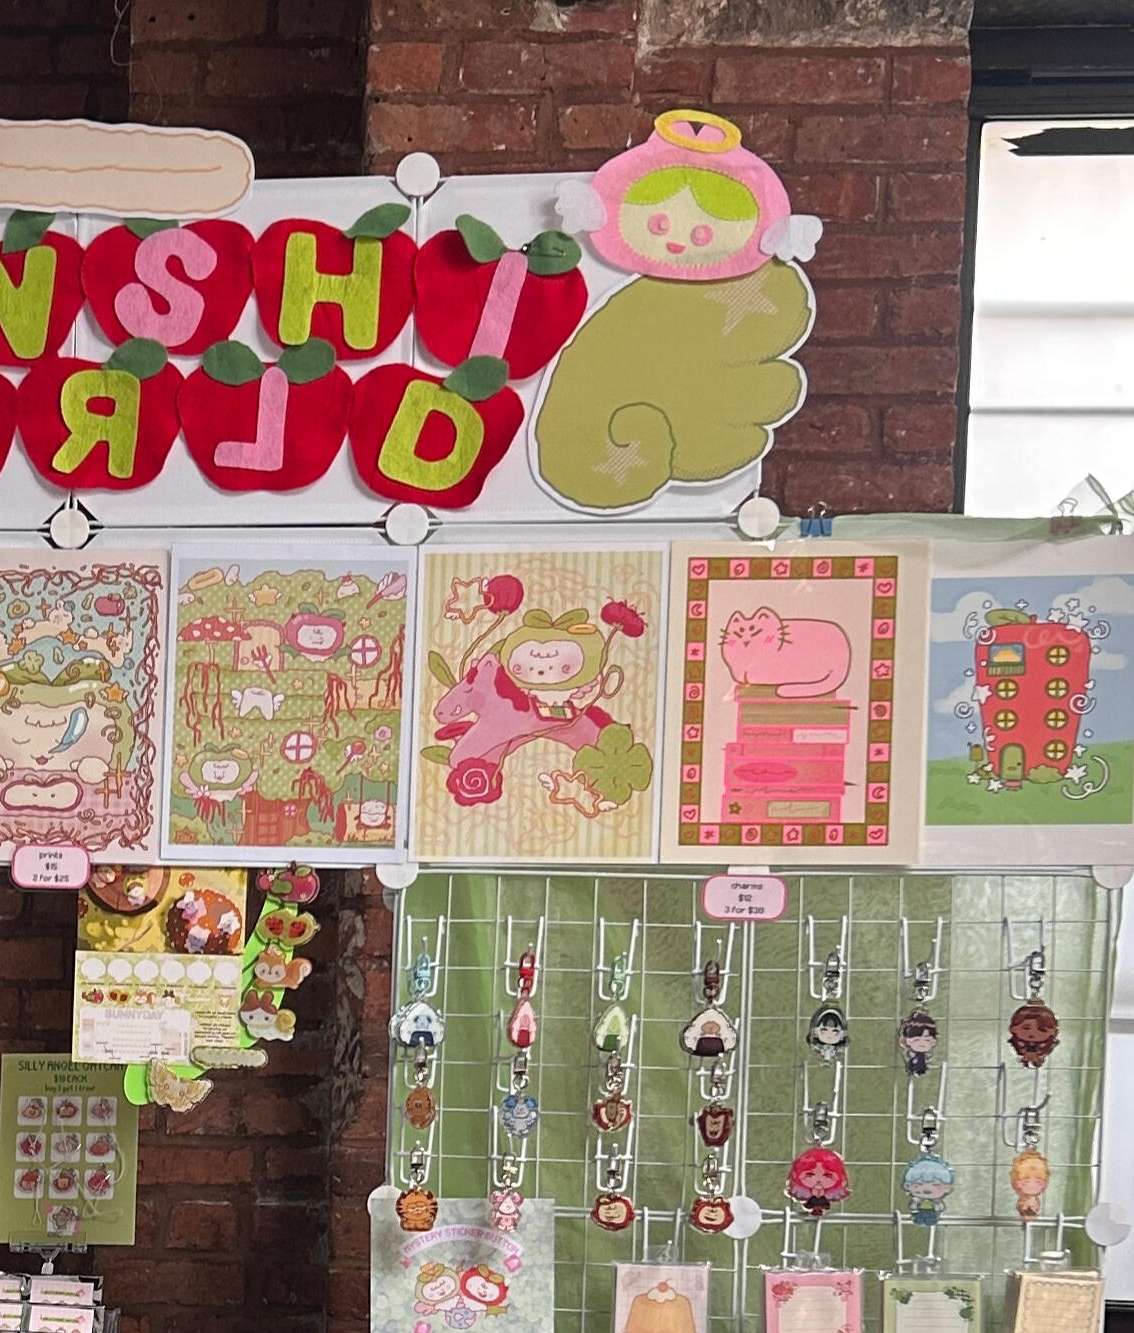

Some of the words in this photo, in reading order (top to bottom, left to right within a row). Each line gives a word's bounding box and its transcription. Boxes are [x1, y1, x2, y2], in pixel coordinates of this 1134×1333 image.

[39, 852, 63, 860] prints
[45, 862, 58, 871] $15
[39, 874, 53, 882] for
[18, 1060, 46, 1072] SILLY
[47, 1061, 81, 1072] ANGEL
[66, 1074, 87, 1083] EACH
[403, 1230, 443, 1254] MYSTERY
[445, 1228, 484, 1237] STICKER
